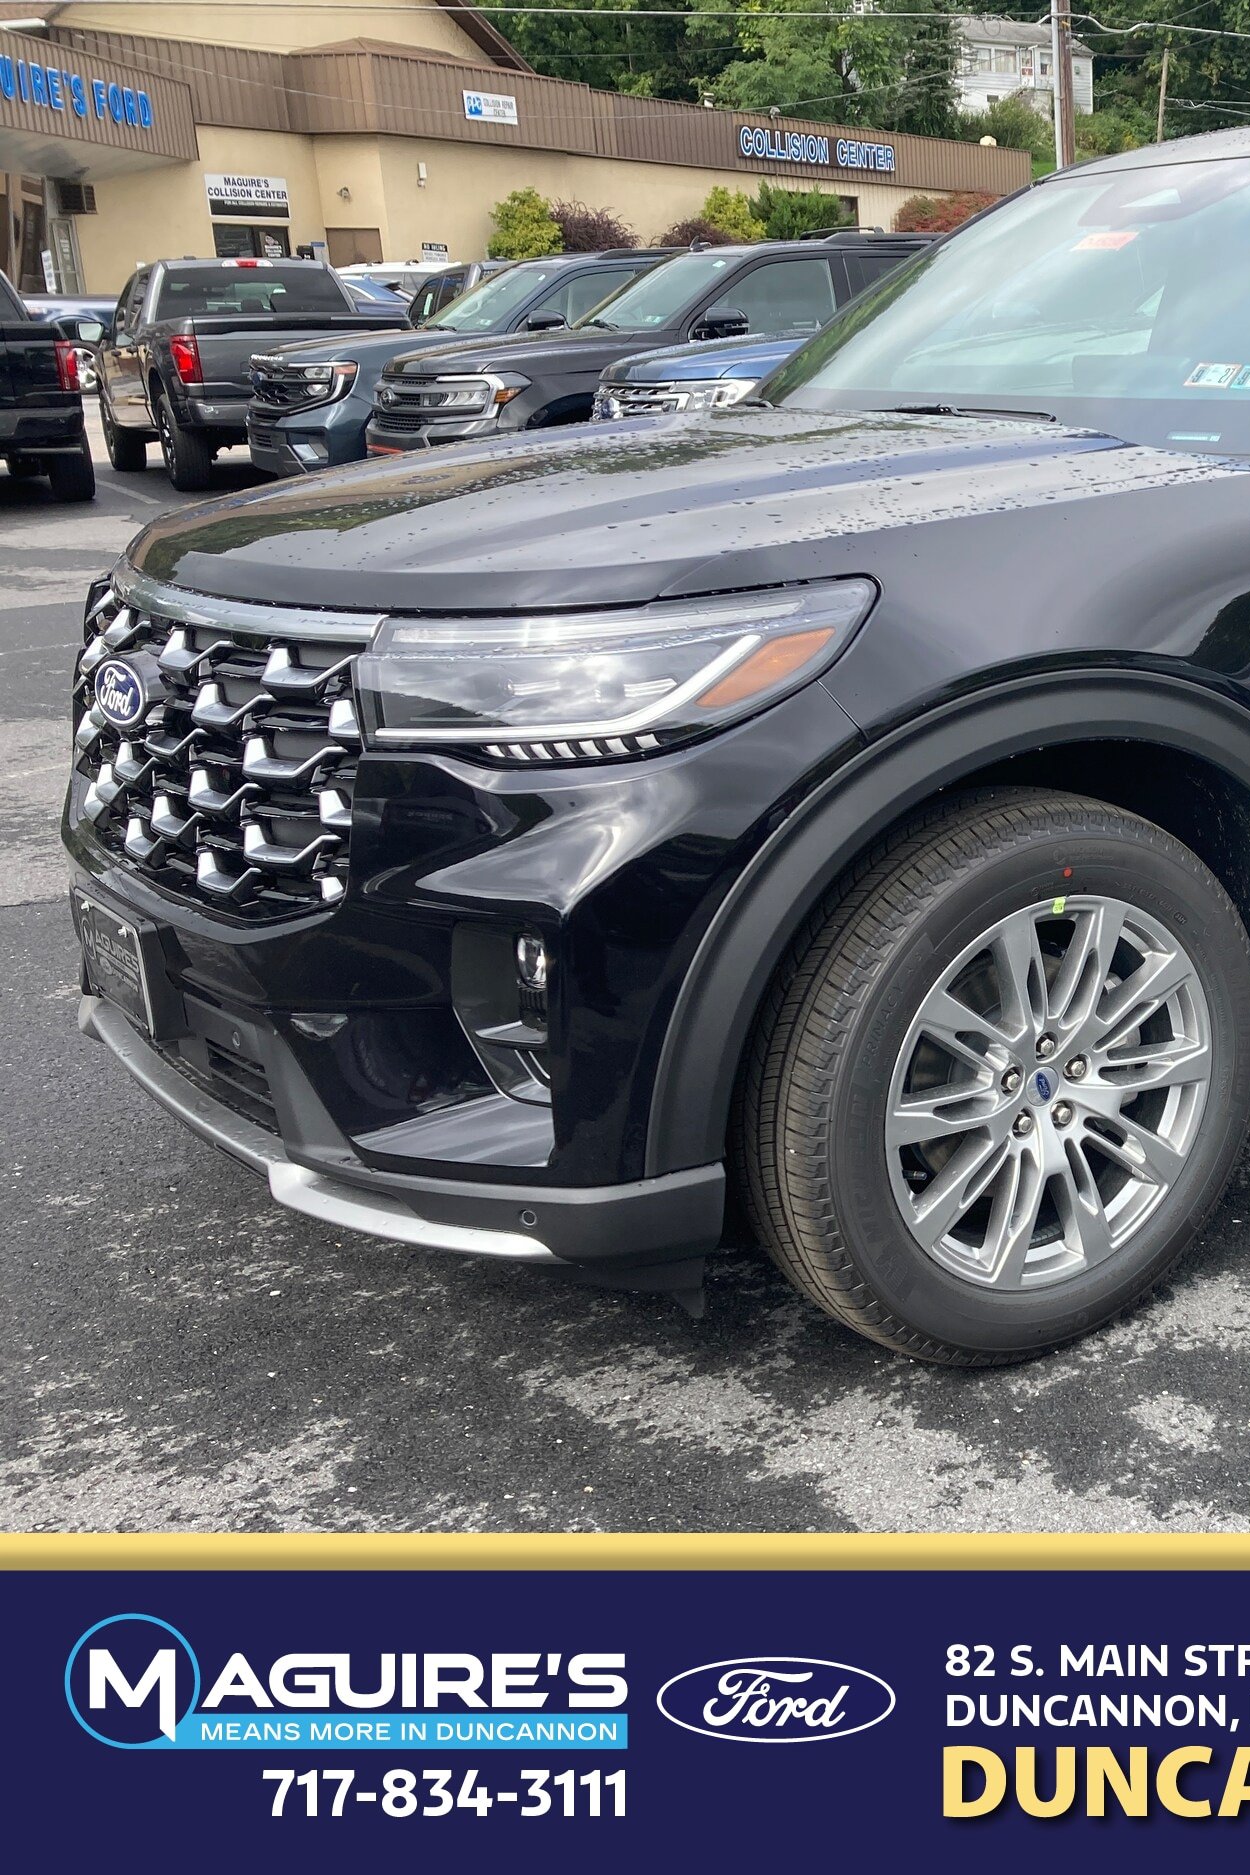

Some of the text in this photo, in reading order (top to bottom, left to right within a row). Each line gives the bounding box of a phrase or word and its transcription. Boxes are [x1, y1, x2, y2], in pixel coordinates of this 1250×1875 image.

[92, 78, 153, 129] FORD
[740, 126, 896, 172] COLLISION CENTER
[207, 187, 288, 200] COLLISION CENTER
[223, 176, 270, 189] MAGUIRE'S
[100, 666, 134, 717] Ford
